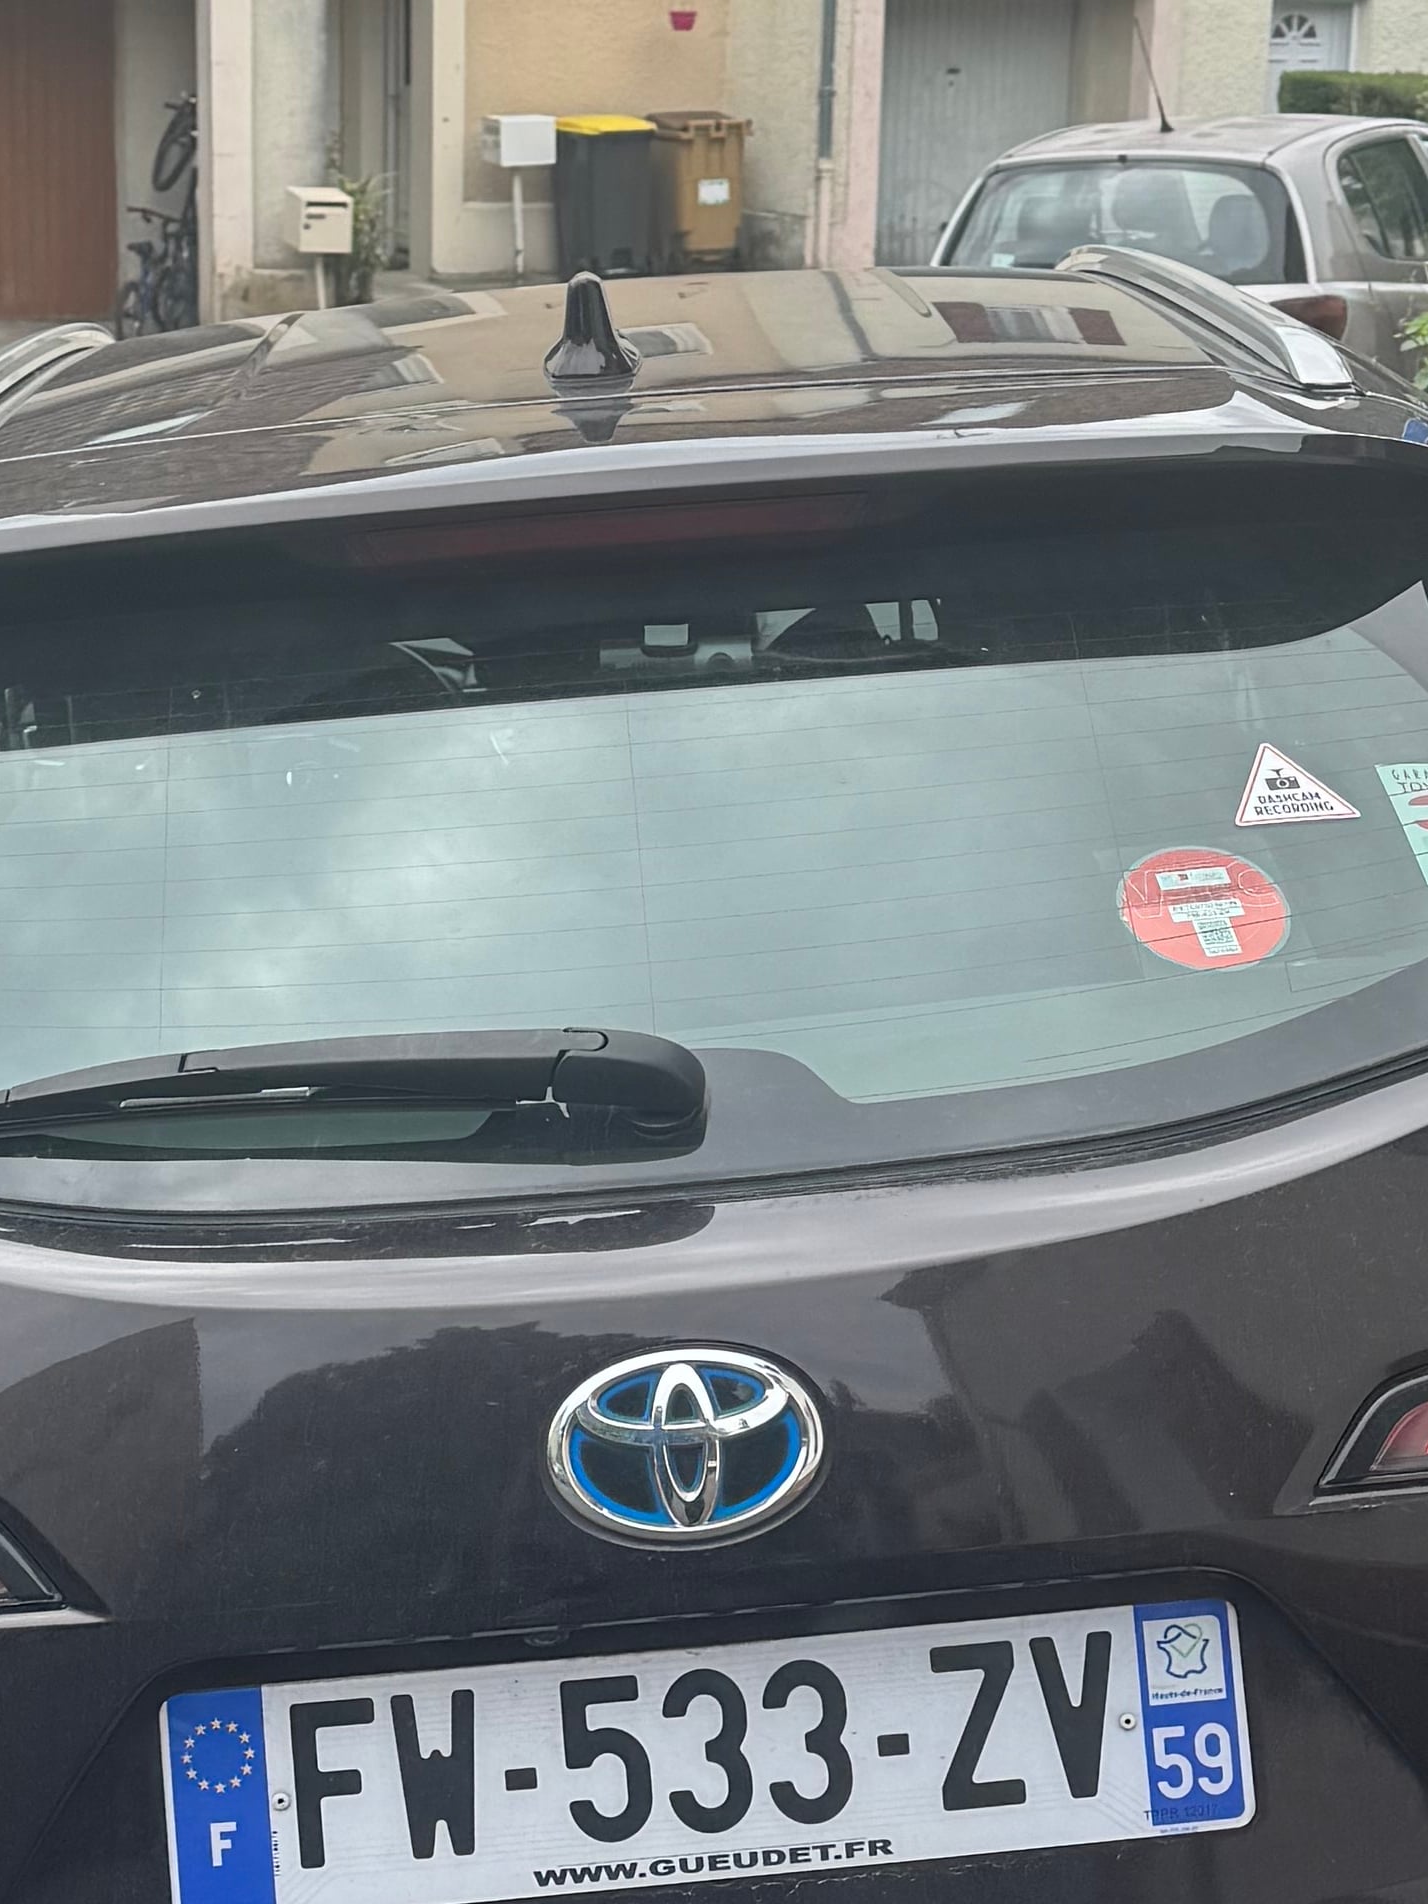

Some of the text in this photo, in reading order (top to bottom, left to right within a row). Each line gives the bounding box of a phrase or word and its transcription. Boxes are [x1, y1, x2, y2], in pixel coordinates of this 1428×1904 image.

[1254, 800, 1334, 816] RECORDING
[1257, 792, 1322, 804] DASHCAM
[288, 1629, 1113, 1869] FW-533-ZV
[1152, 1722, 1234, 1800] 59
[209, 1821, 238, 1868] F
[532, 1838, 895, 1888] WWW.GUEUDET.FR
